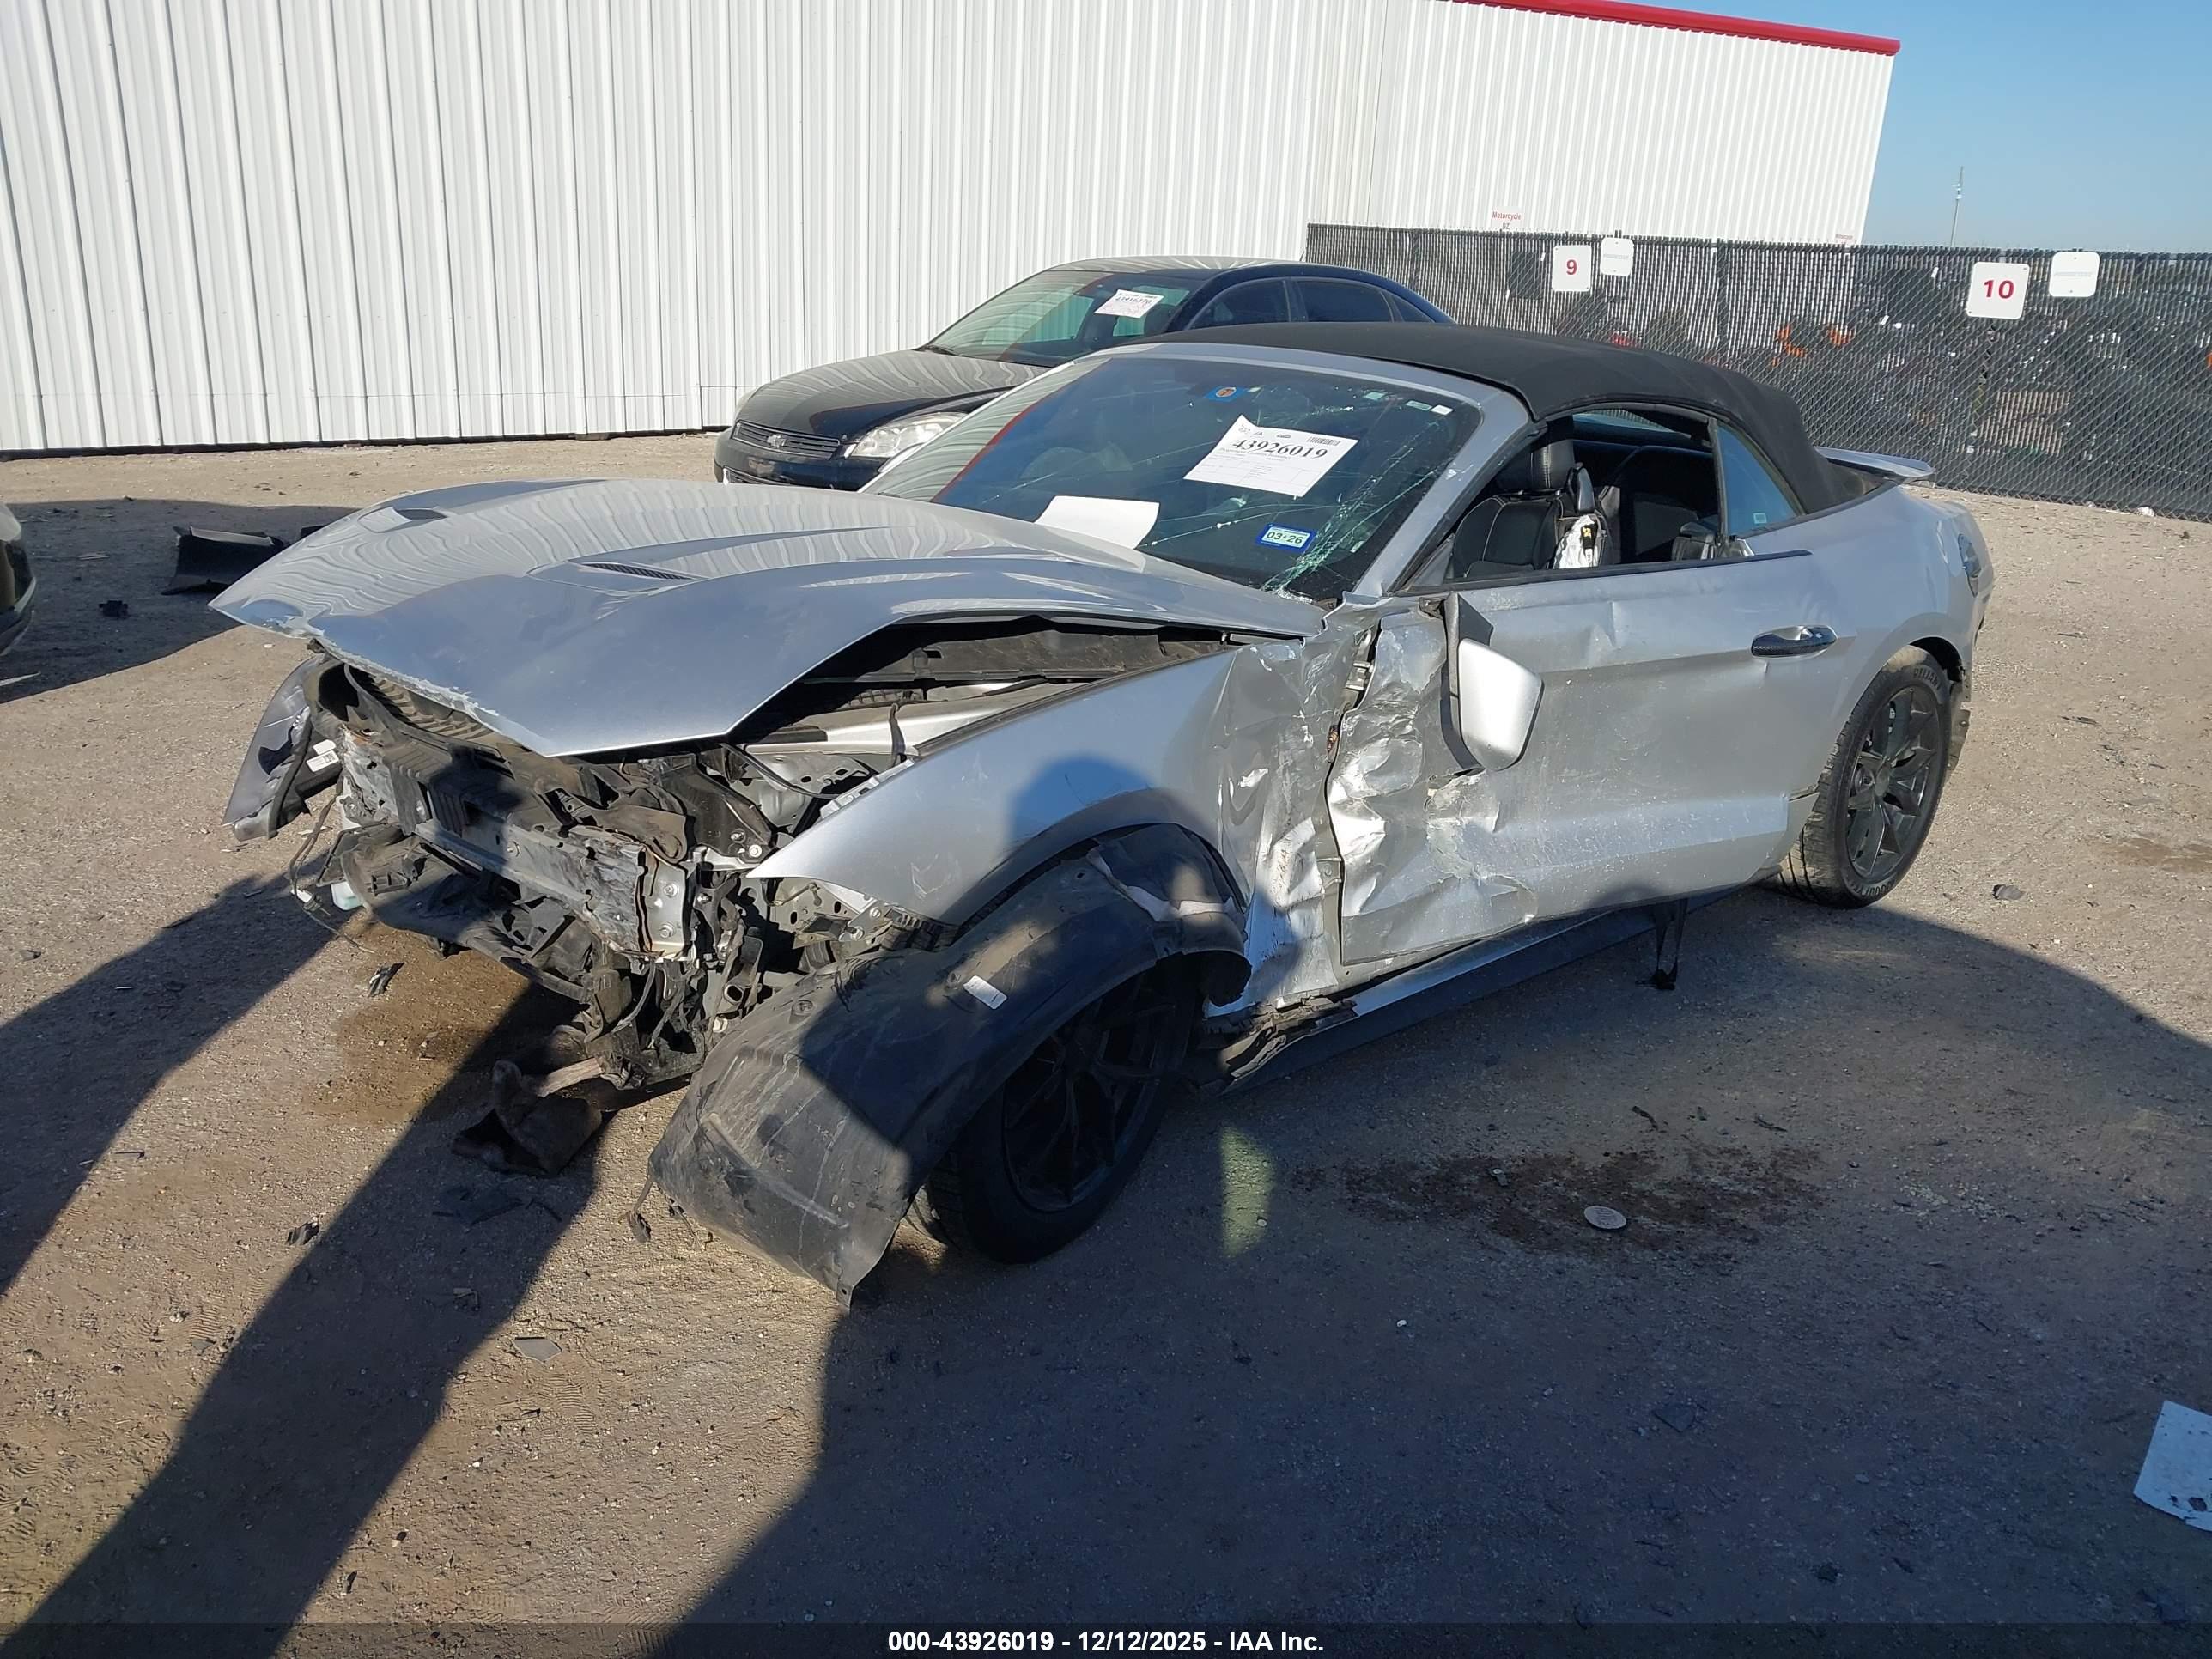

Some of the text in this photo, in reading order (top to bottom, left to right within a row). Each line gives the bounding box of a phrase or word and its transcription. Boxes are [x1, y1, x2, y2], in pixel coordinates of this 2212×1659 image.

[1492, 211, 1521, 221] Motorcycle
[1565, 259, 1577, 276] 9
[1984, 279, 2014, 299] 10
[1232, 439, 1328, 459] 43926019
[1267, 531, 1304, 544] 03 26
